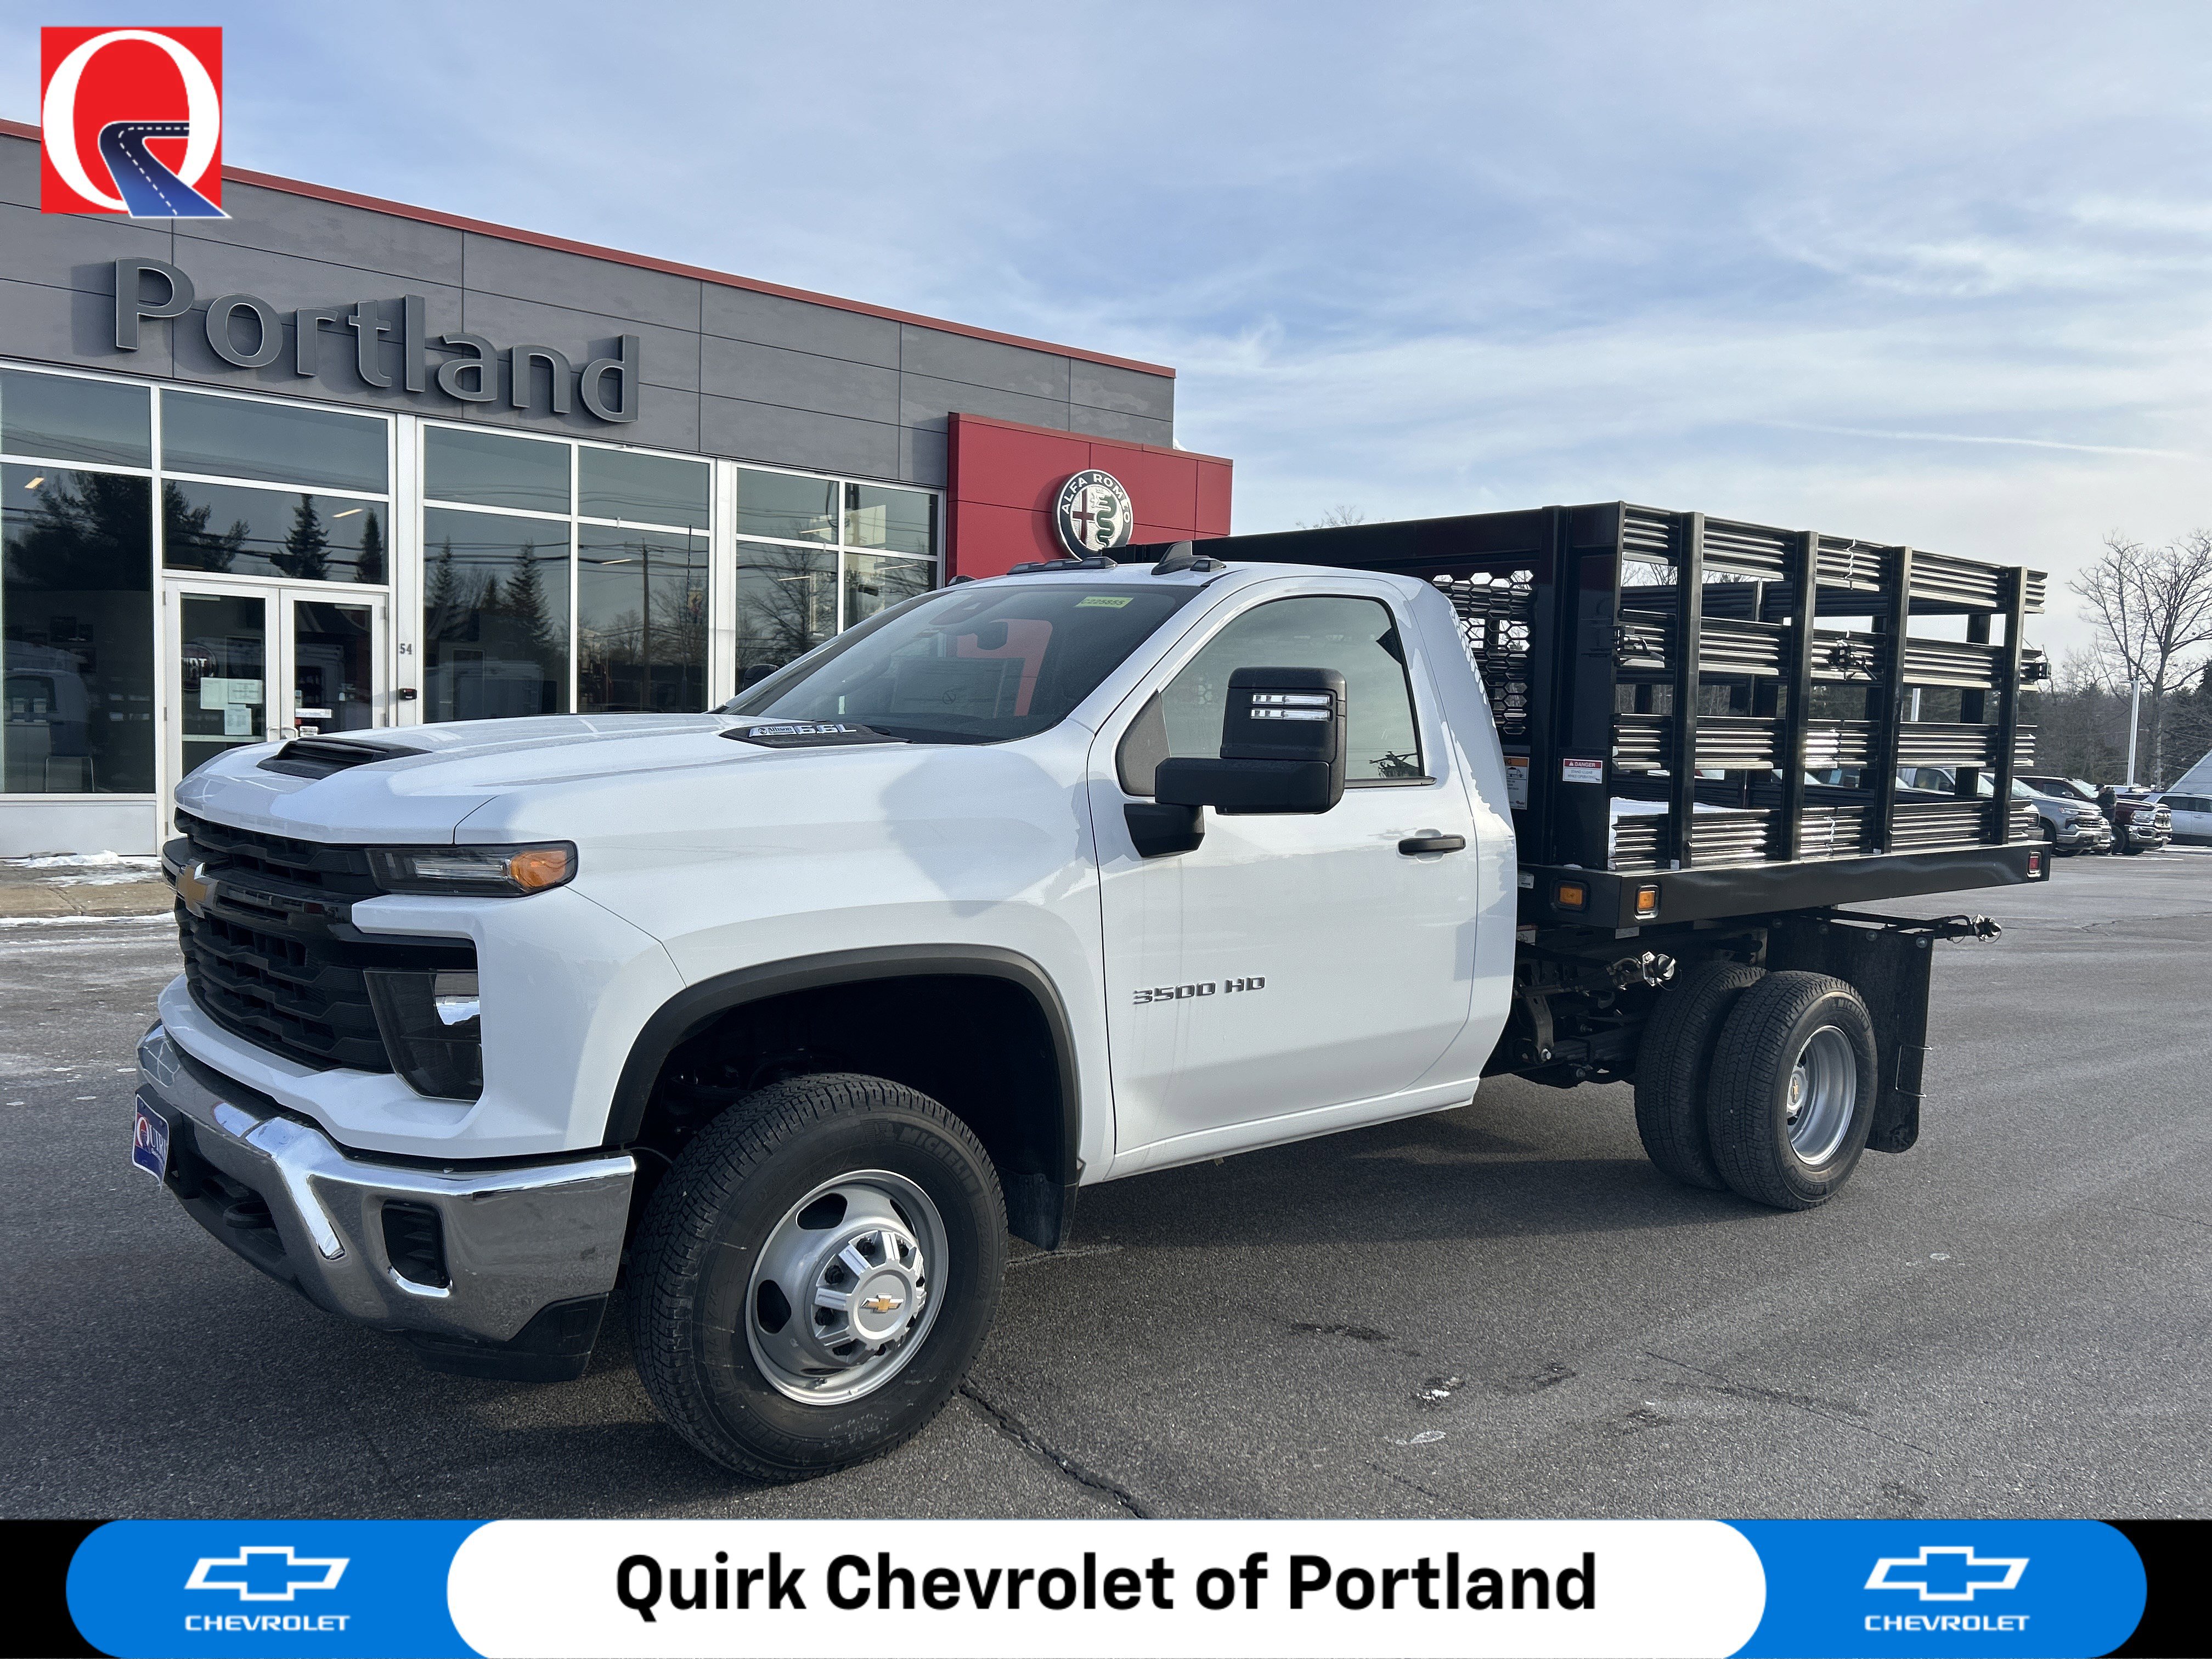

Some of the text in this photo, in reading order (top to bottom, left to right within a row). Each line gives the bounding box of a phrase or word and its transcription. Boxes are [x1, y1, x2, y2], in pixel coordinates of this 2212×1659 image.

[115, 257, 640, 423] Portland
[1061, 473, 1131, 523] ALFA ROMEO
[400, 643, 412, 655] 54
[795, 724, 857, 735] 6.6L
[1132, 975, 1266, 1005] 3500 HD
[1837, 998, 1869, 1029] MICHELIN
[898, 1126, 980, 1198] MICHELIN
